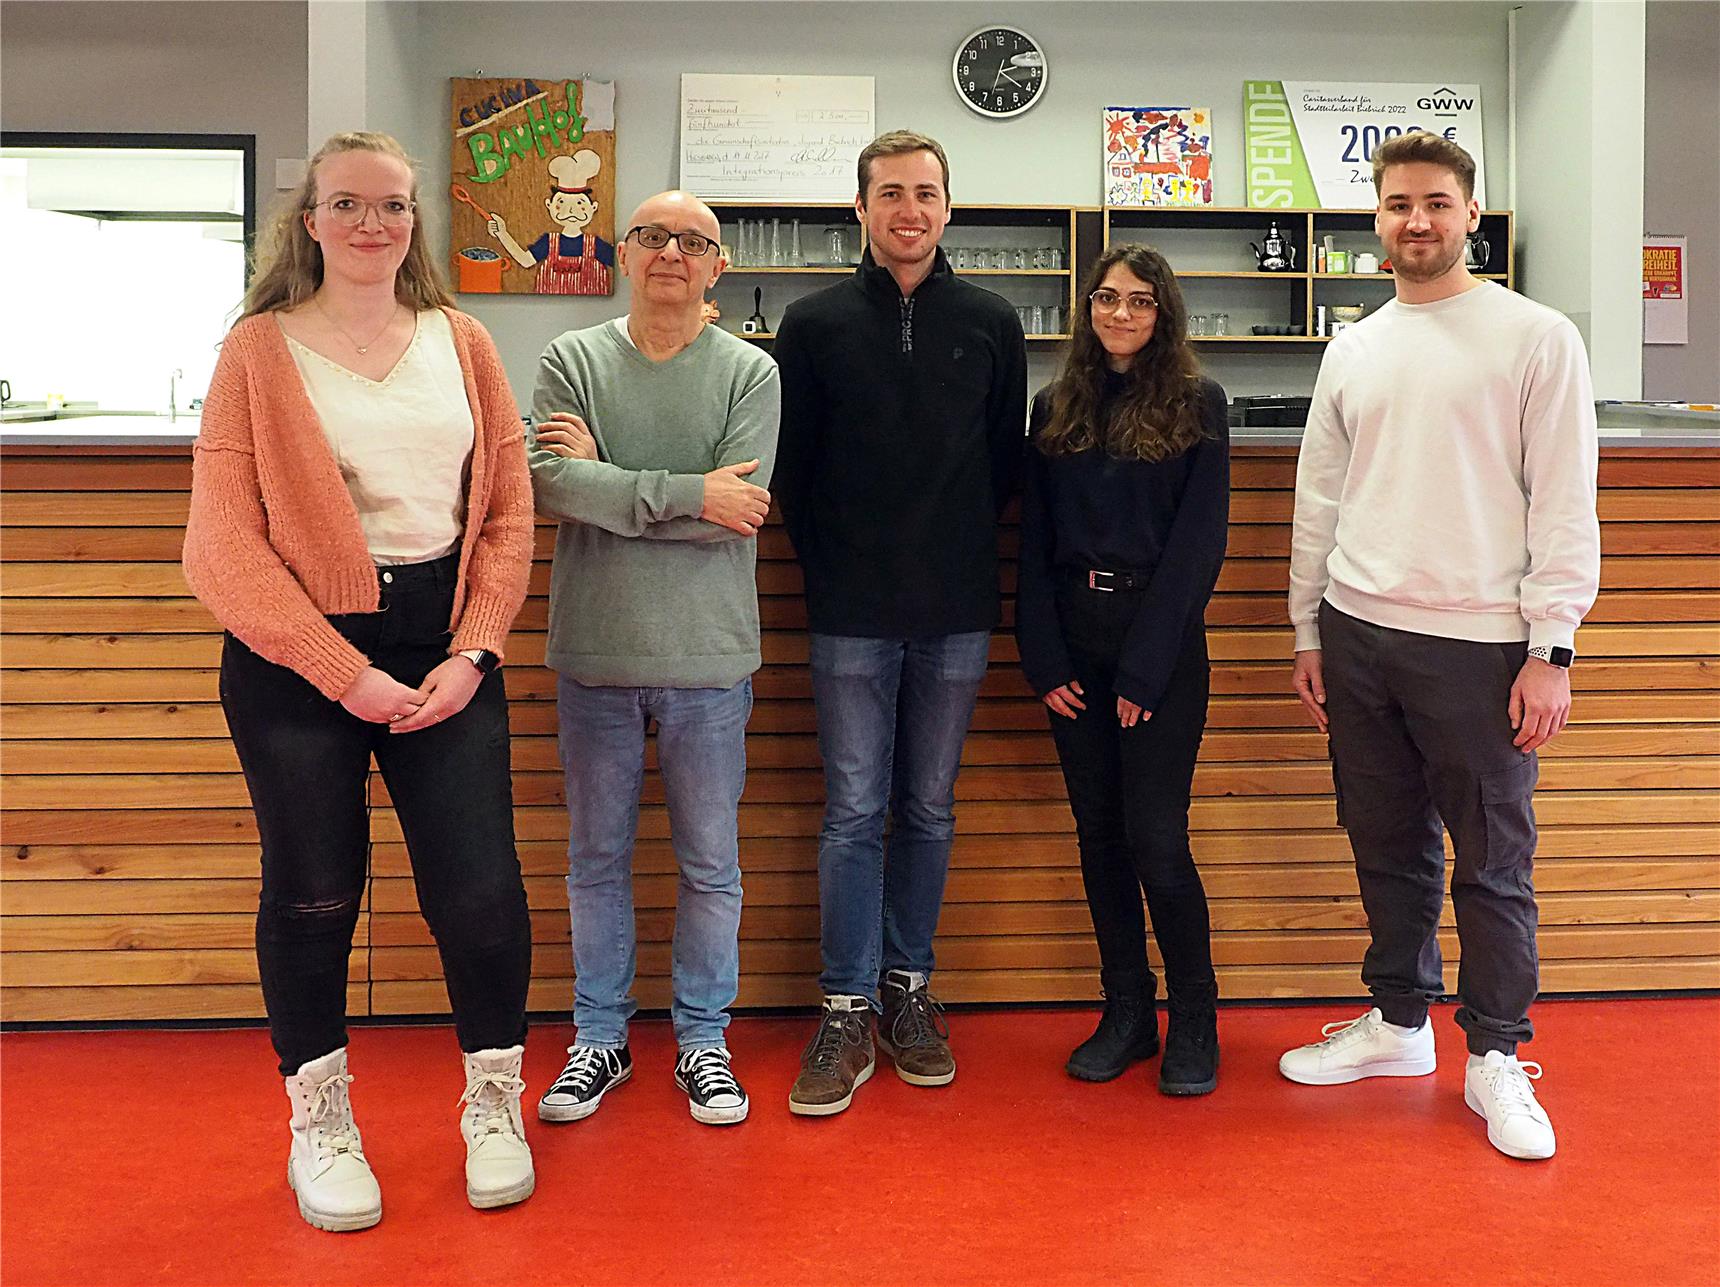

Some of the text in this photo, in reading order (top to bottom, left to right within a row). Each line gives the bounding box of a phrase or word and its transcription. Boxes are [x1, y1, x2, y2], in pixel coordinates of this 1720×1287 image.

[980, 40, 987, 49] 11
[995, 36, 1004, 46] 12
[1014, 40, 1018, 50] 1
[969, 50, 977, 60] 10
[963, 65, 969, 75] 9
[1031, 67, 1036, 77] 3
[969, 81, 975, 91] 8
[1025, 82, 1031, 91] 4
[982, 92, 988, 102] 7
[997, 96, 1002, 106] 6
[1013, 92, 1018, 102] 5
[1303, 94, 1372, 107] Caritasverband für
[460, 79, 541, 127] CUCINA
[1417, 98, 1474, 110] GWW
[1304, 104, 1408, 114] Stadtteilarbeit Biebrich 2022
[1341, 125, 1457, 163] 20 €
